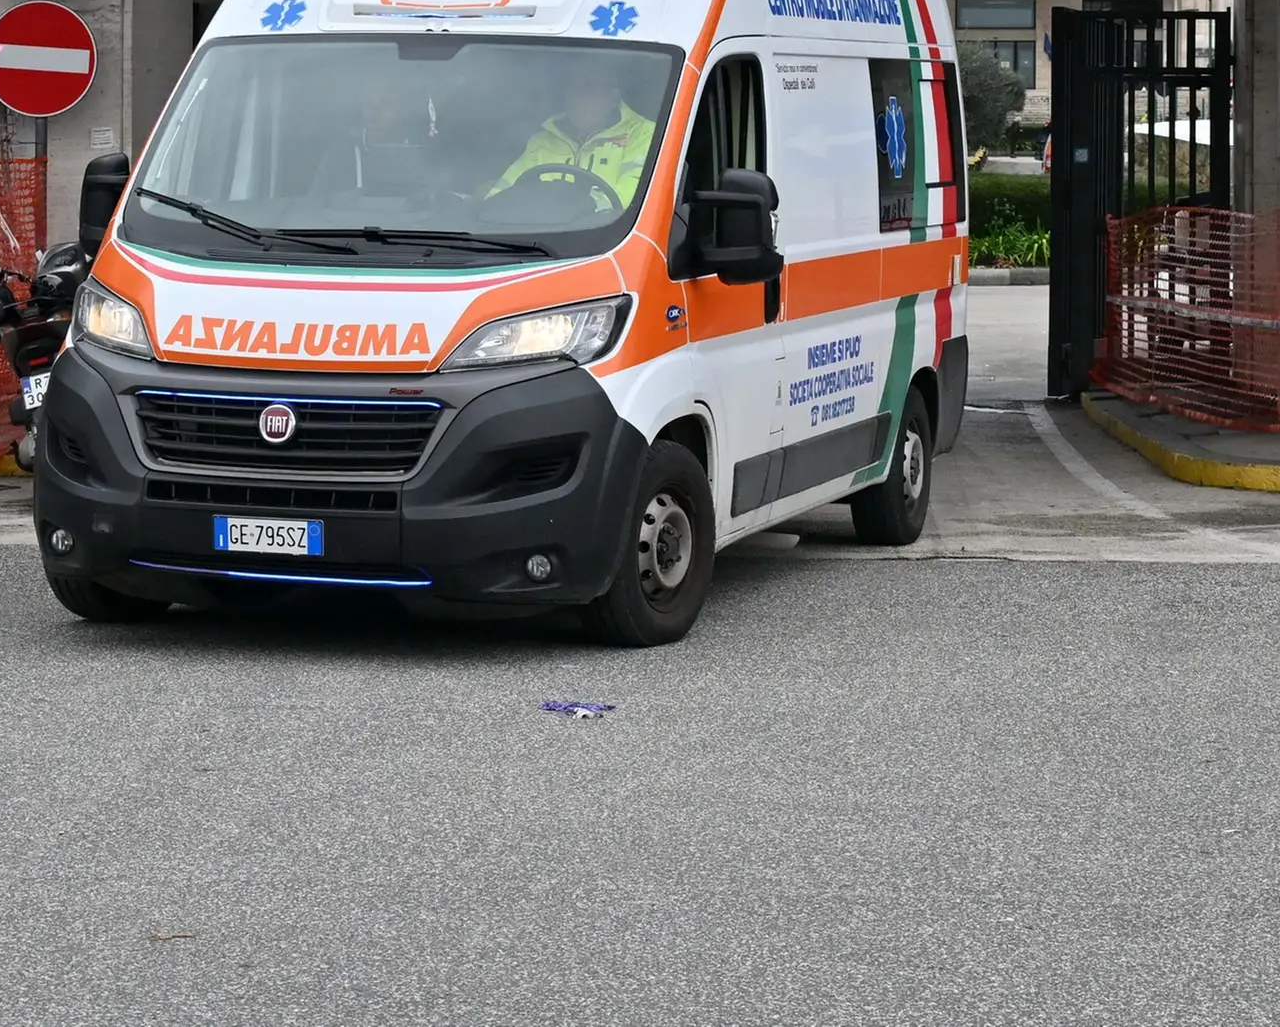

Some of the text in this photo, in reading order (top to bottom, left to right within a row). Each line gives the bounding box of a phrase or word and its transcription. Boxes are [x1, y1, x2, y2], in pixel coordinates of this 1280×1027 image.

[807, 341, 837, 369] INSIEME
[837, 339, 845, 362] SI
[388, 387, 425, 396] Power
[814, 367, 852, 399] COOPERATIVA
[851, 361, 875, 388] SOCIALE
[266, 416, 288, 434] FIAT
